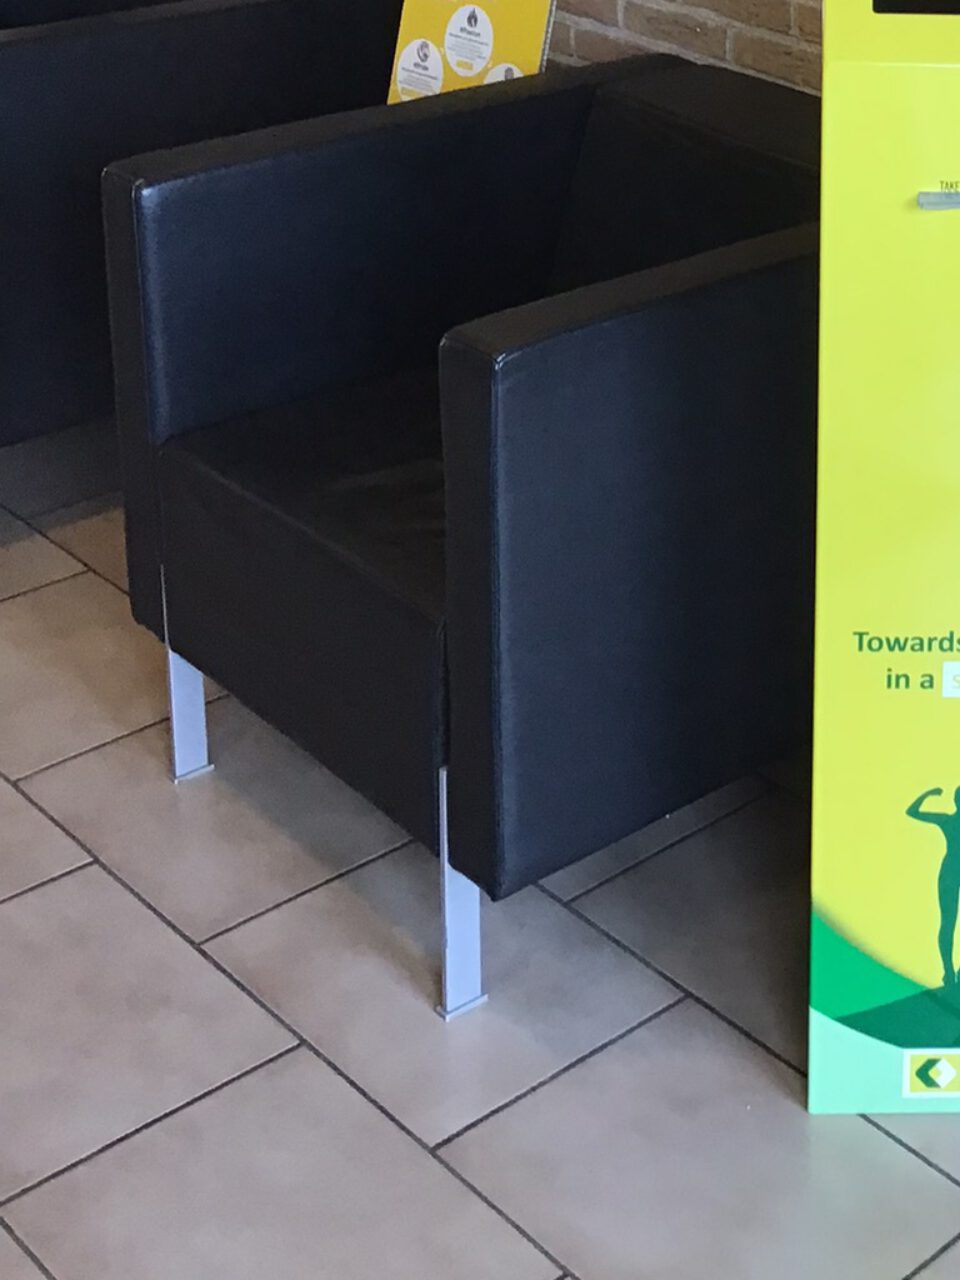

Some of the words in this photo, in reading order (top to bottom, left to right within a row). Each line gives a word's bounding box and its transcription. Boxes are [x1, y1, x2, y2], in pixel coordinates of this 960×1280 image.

[940, 180, 960, 193] TAKE
[886, 667, 910, 690] in
[919, 673, 935, 690] a
